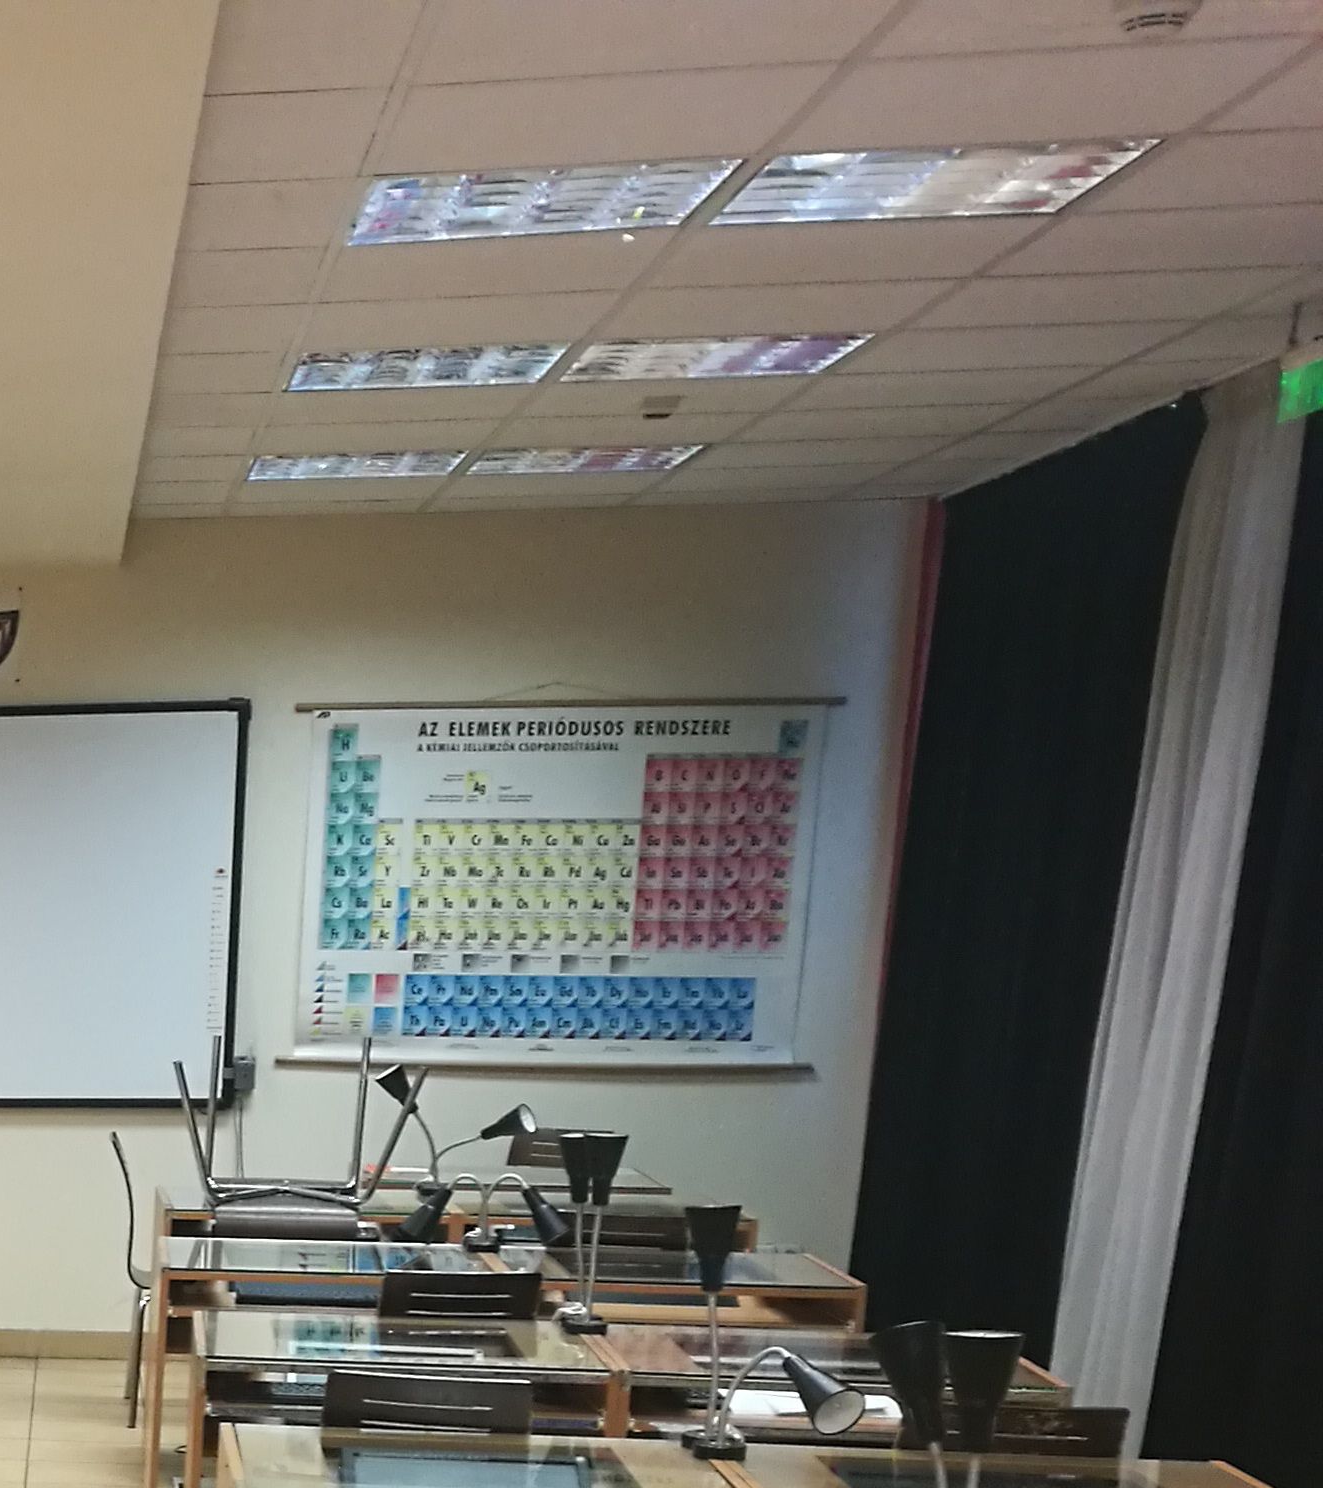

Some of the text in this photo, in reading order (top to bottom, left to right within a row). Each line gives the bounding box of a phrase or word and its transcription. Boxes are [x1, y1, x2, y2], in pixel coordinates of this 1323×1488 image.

[418, 717, 731, 737] AZ ELEMEK PERIÓDUSOS RENDSZERE
